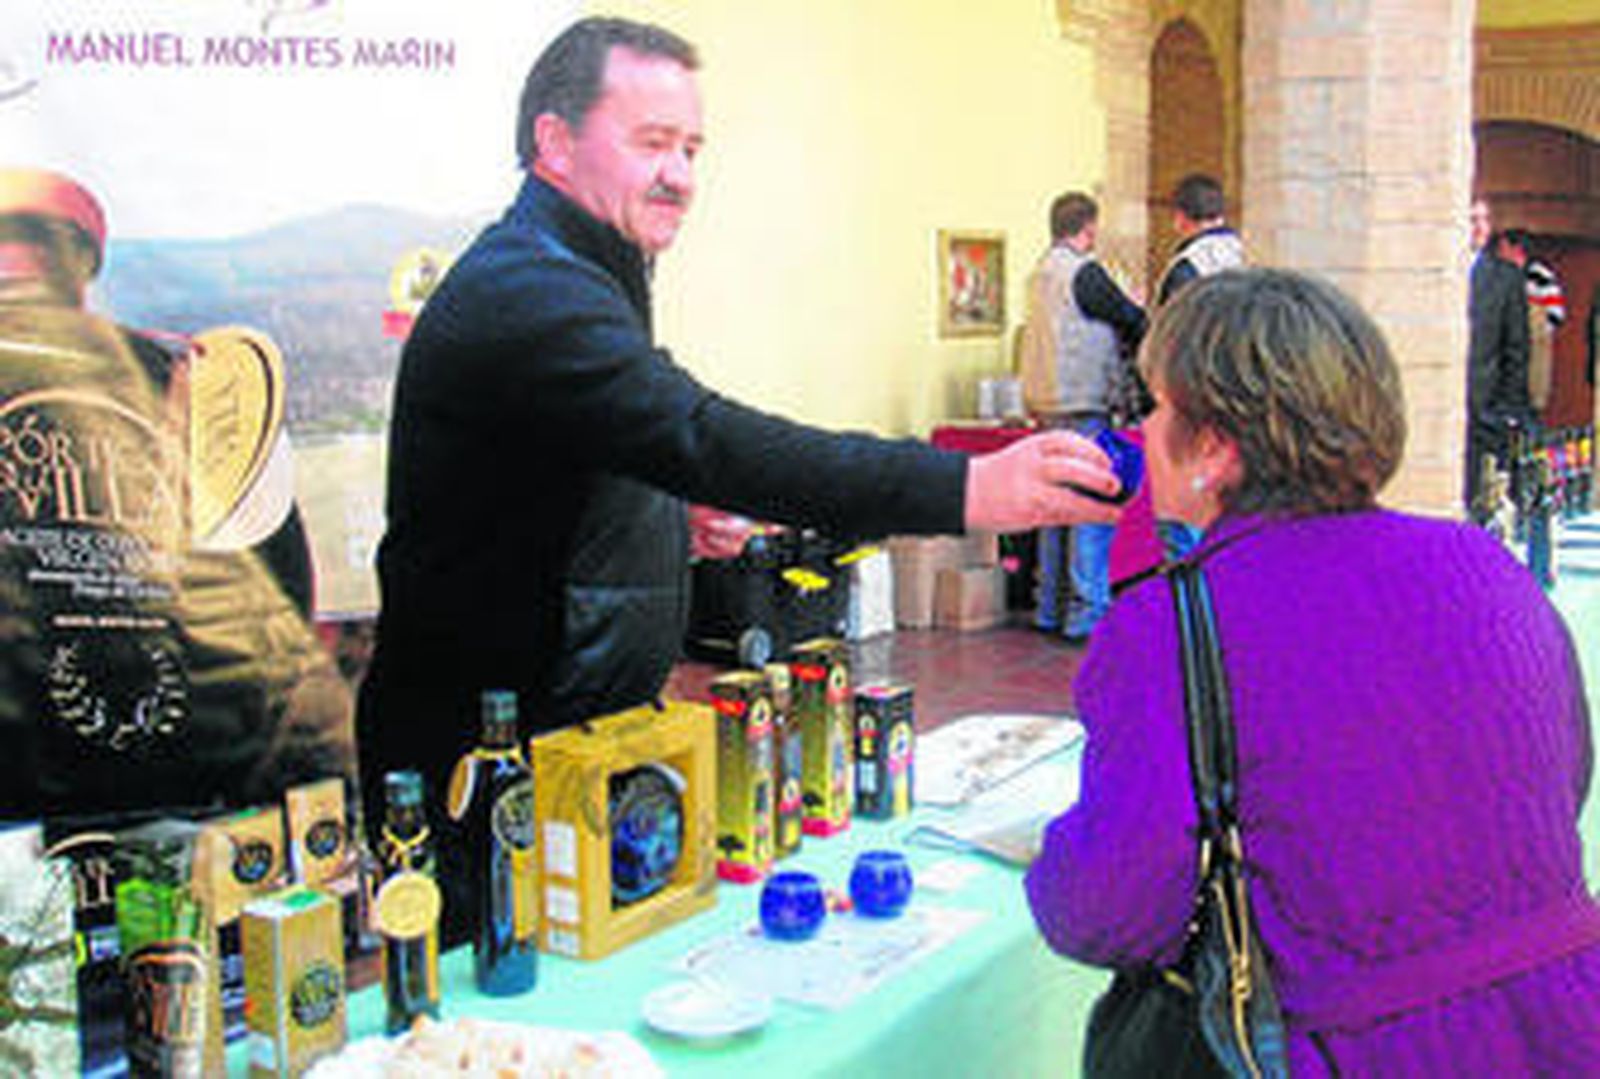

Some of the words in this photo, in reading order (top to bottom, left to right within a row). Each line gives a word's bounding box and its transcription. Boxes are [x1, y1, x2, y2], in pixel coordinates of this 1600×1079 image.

[46, 33, 191, 66] MANUEL
[203, 36, 343, 68] MONTES
[353, 38, 456, 69] MARIN
